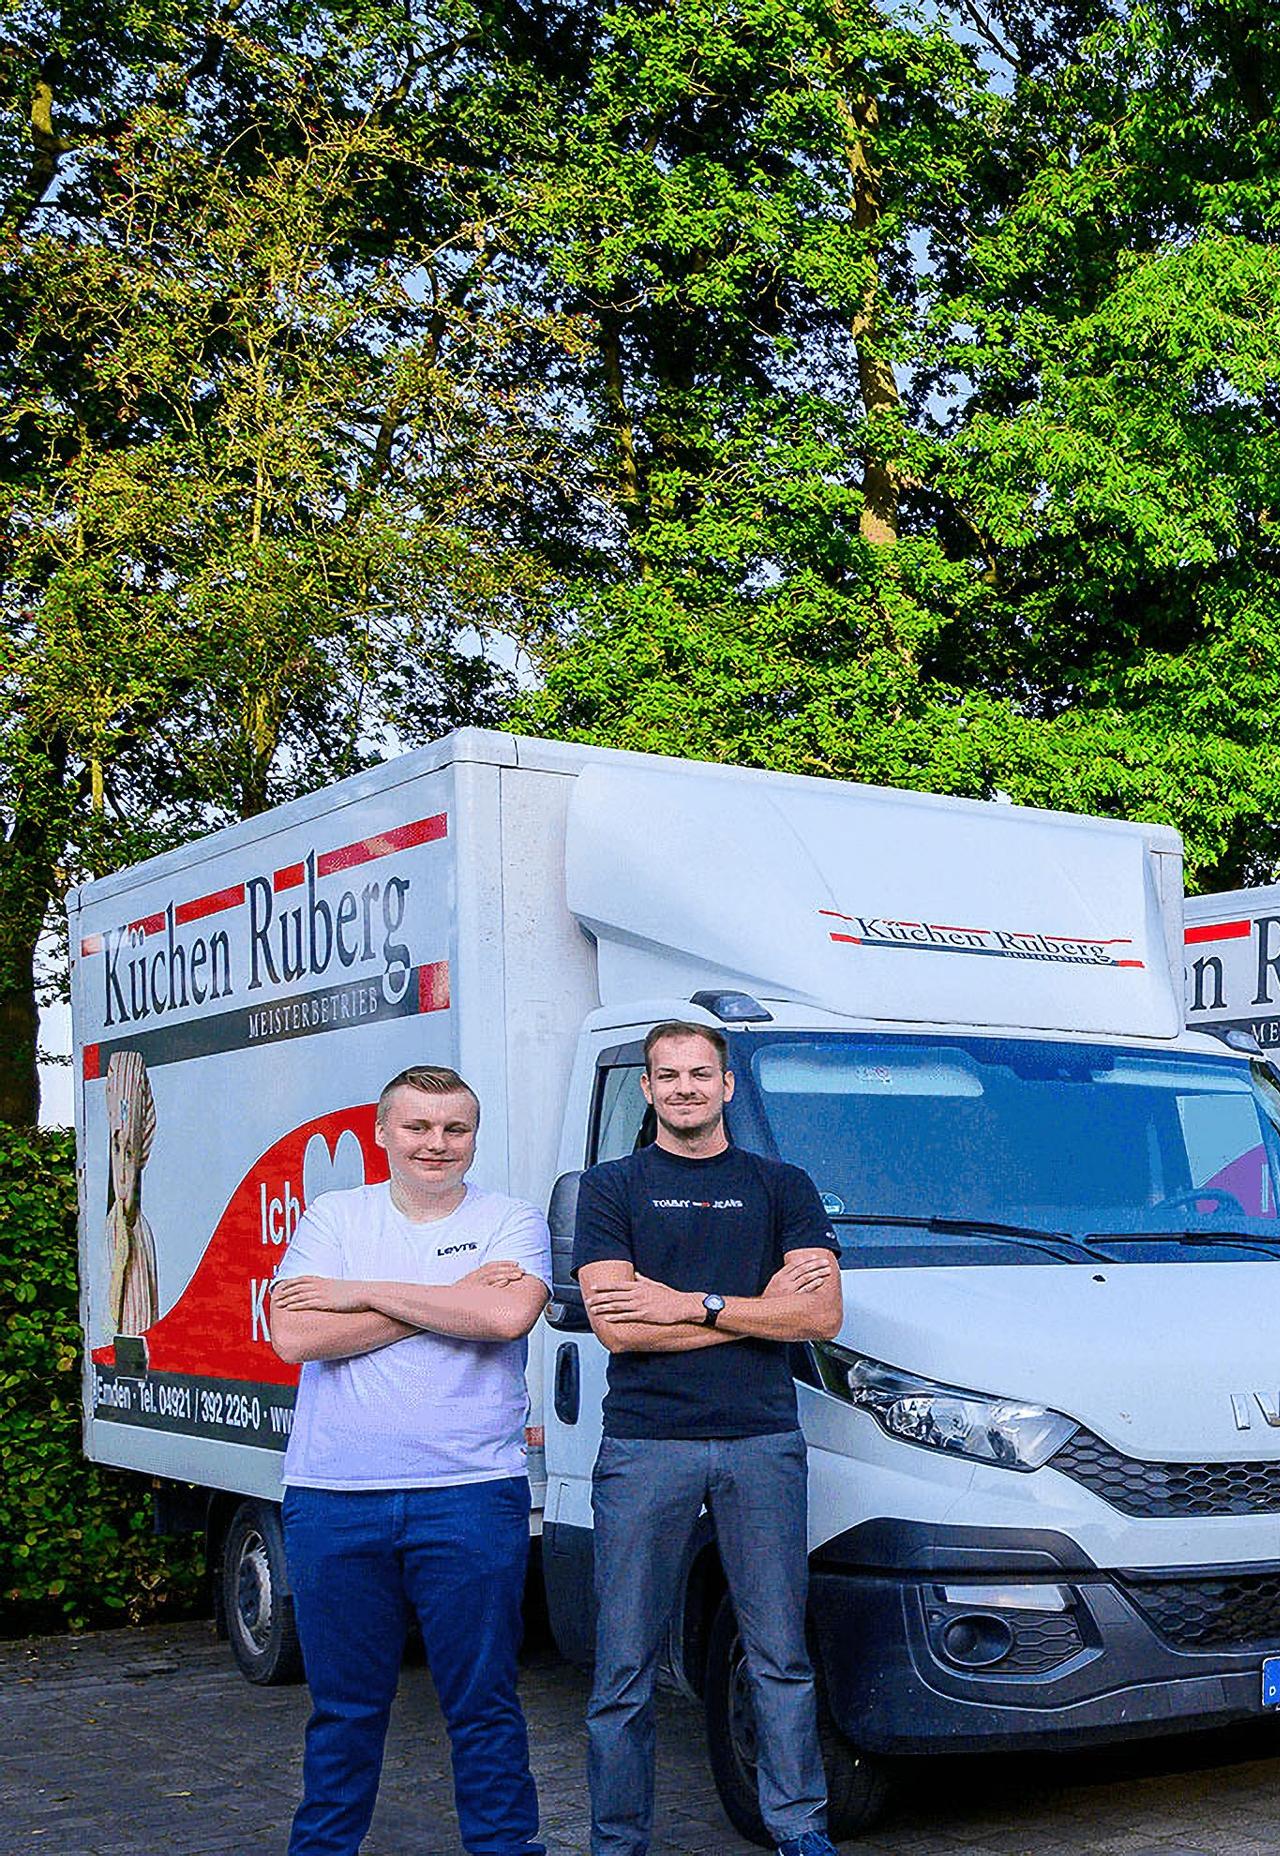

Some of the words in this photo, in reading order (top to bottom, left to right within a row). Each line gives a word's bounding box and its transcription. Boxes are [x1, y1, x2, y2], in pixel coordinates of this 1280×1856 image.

[103, 901, 234, 1026] Küchen
[247, 849, 411, 1005] Ruberg
[854, 917, 988, 948] Küchen
[993, 931, 1114, 966] Ruberg
[1184, 955, 1228, 1012] n
[248, 985, 378, 1039] MEISTERBETRIEB
[260, 1181, 300, 1245] Ich
[138, 1381, 157, 1413] Tel.
[159, 1385, 190, 1418] 04921
[201, 1390, 222, 1424] 392
[225, 1394, 260, 1430] 226-0
